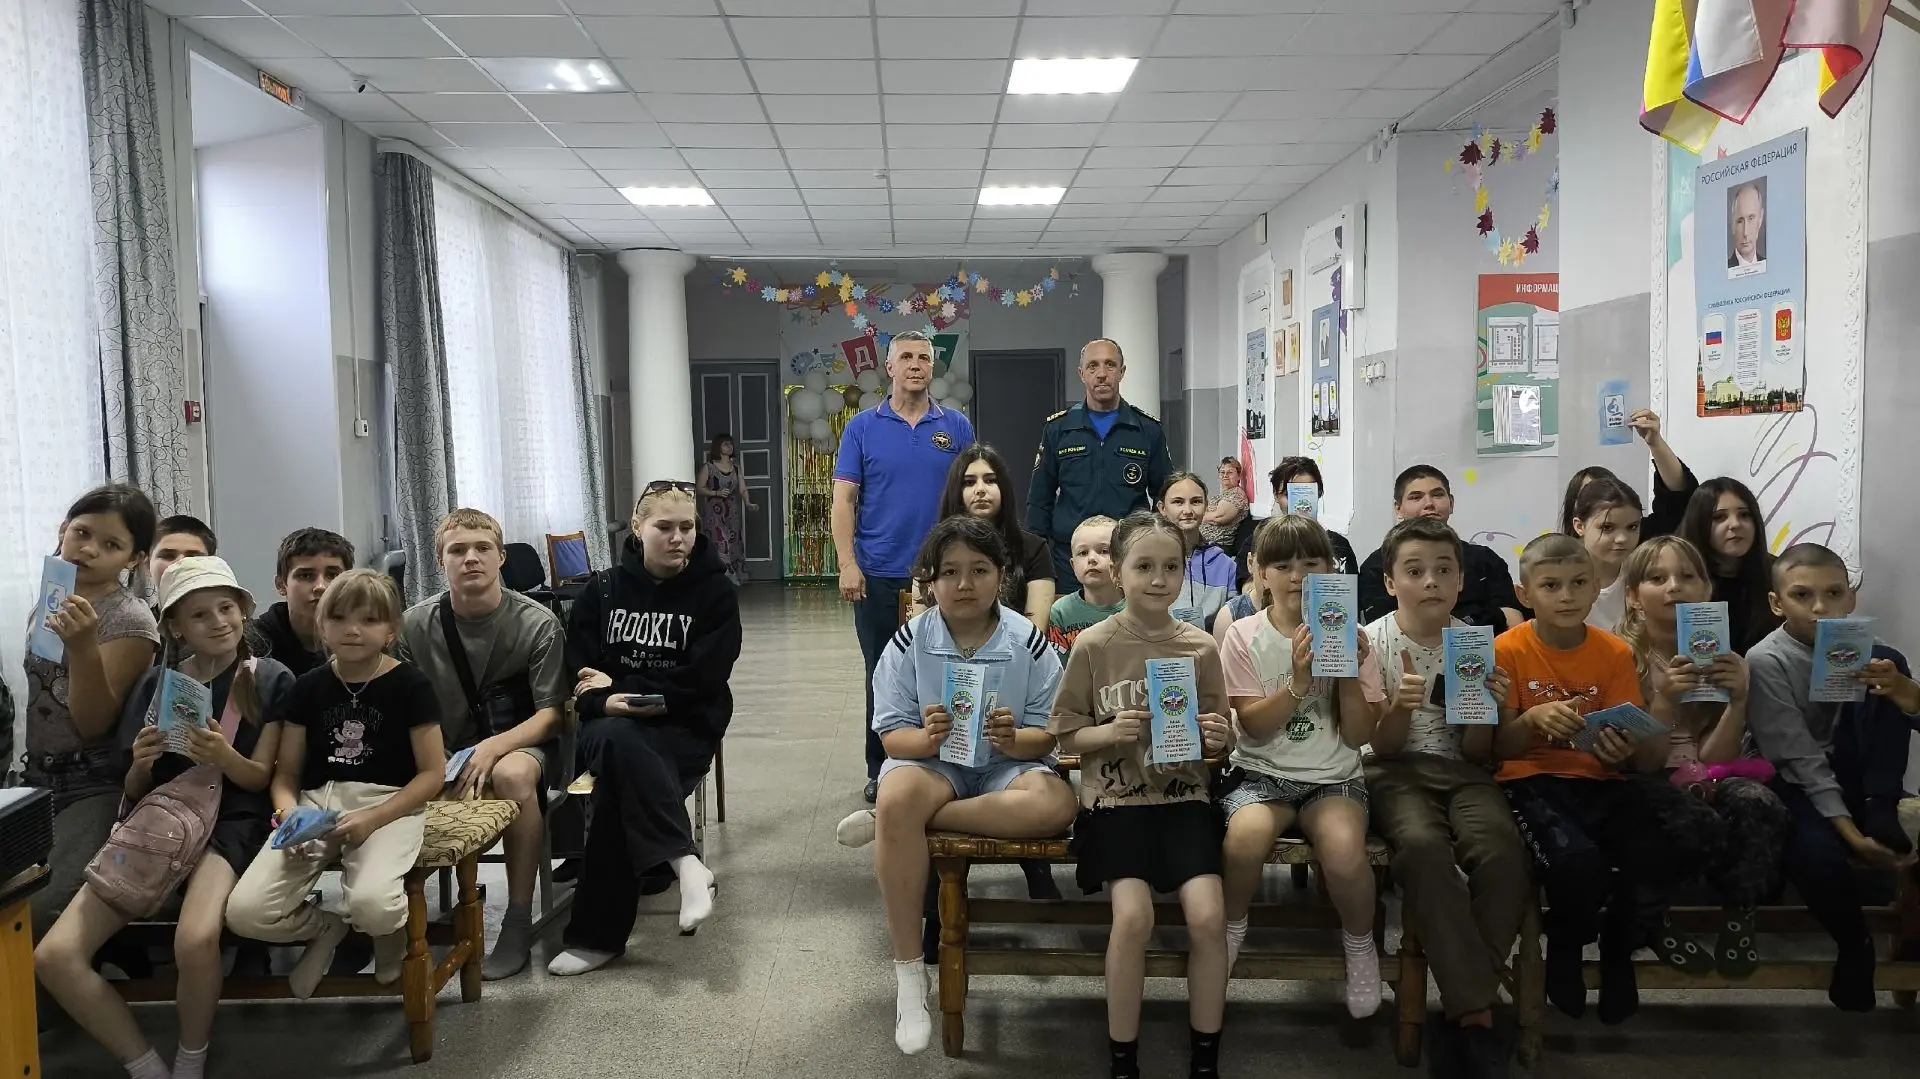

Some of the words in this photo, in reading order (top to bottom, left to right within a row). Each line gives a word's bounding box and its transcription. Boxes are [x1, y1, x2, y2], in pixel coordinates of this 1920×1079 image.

[1701, 160, 1749, 185] РОССИЙСКАЯ
[1750, 142, 1798, 169] ФЕДЕРАЦИЯ
[1516, 283, 1559, 294] ИНФОРМАЦ
[855, 345, 875, 373] Д
[606, 608, 695, 651] ROOKLY
[646, 660, 677, 669] YORK
